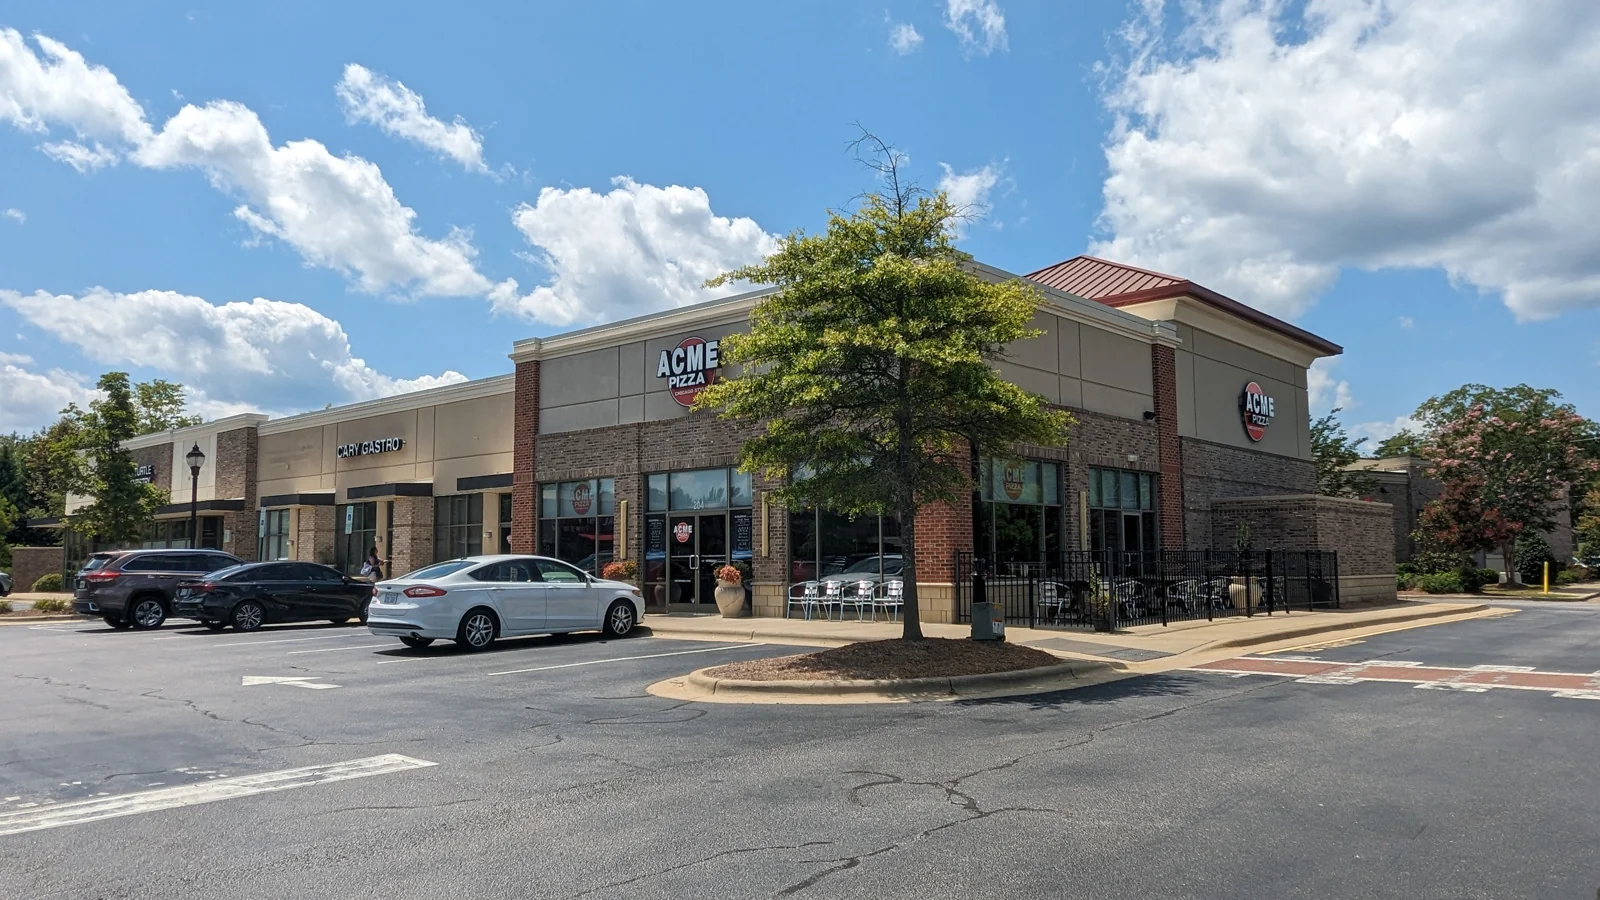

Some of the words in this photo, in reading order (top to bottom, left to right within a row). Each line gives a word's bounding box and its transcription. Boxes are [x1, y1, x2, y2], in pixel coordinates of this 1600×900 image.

[657, 341, 718, 377] ACME
[669, 372, 705, 390] PIZZA
[674, 388, 693, 396] CHICAGO
[1246, 391, 1275, 417] ACME
[1252, 414, 1269, 426] PIZZA
[337, 442, 359, 458] CARY
[362, 437, 399, 455] GASTRO
[693, 500, 705, 510] 204
[673, 525, 693, 534] ACME
